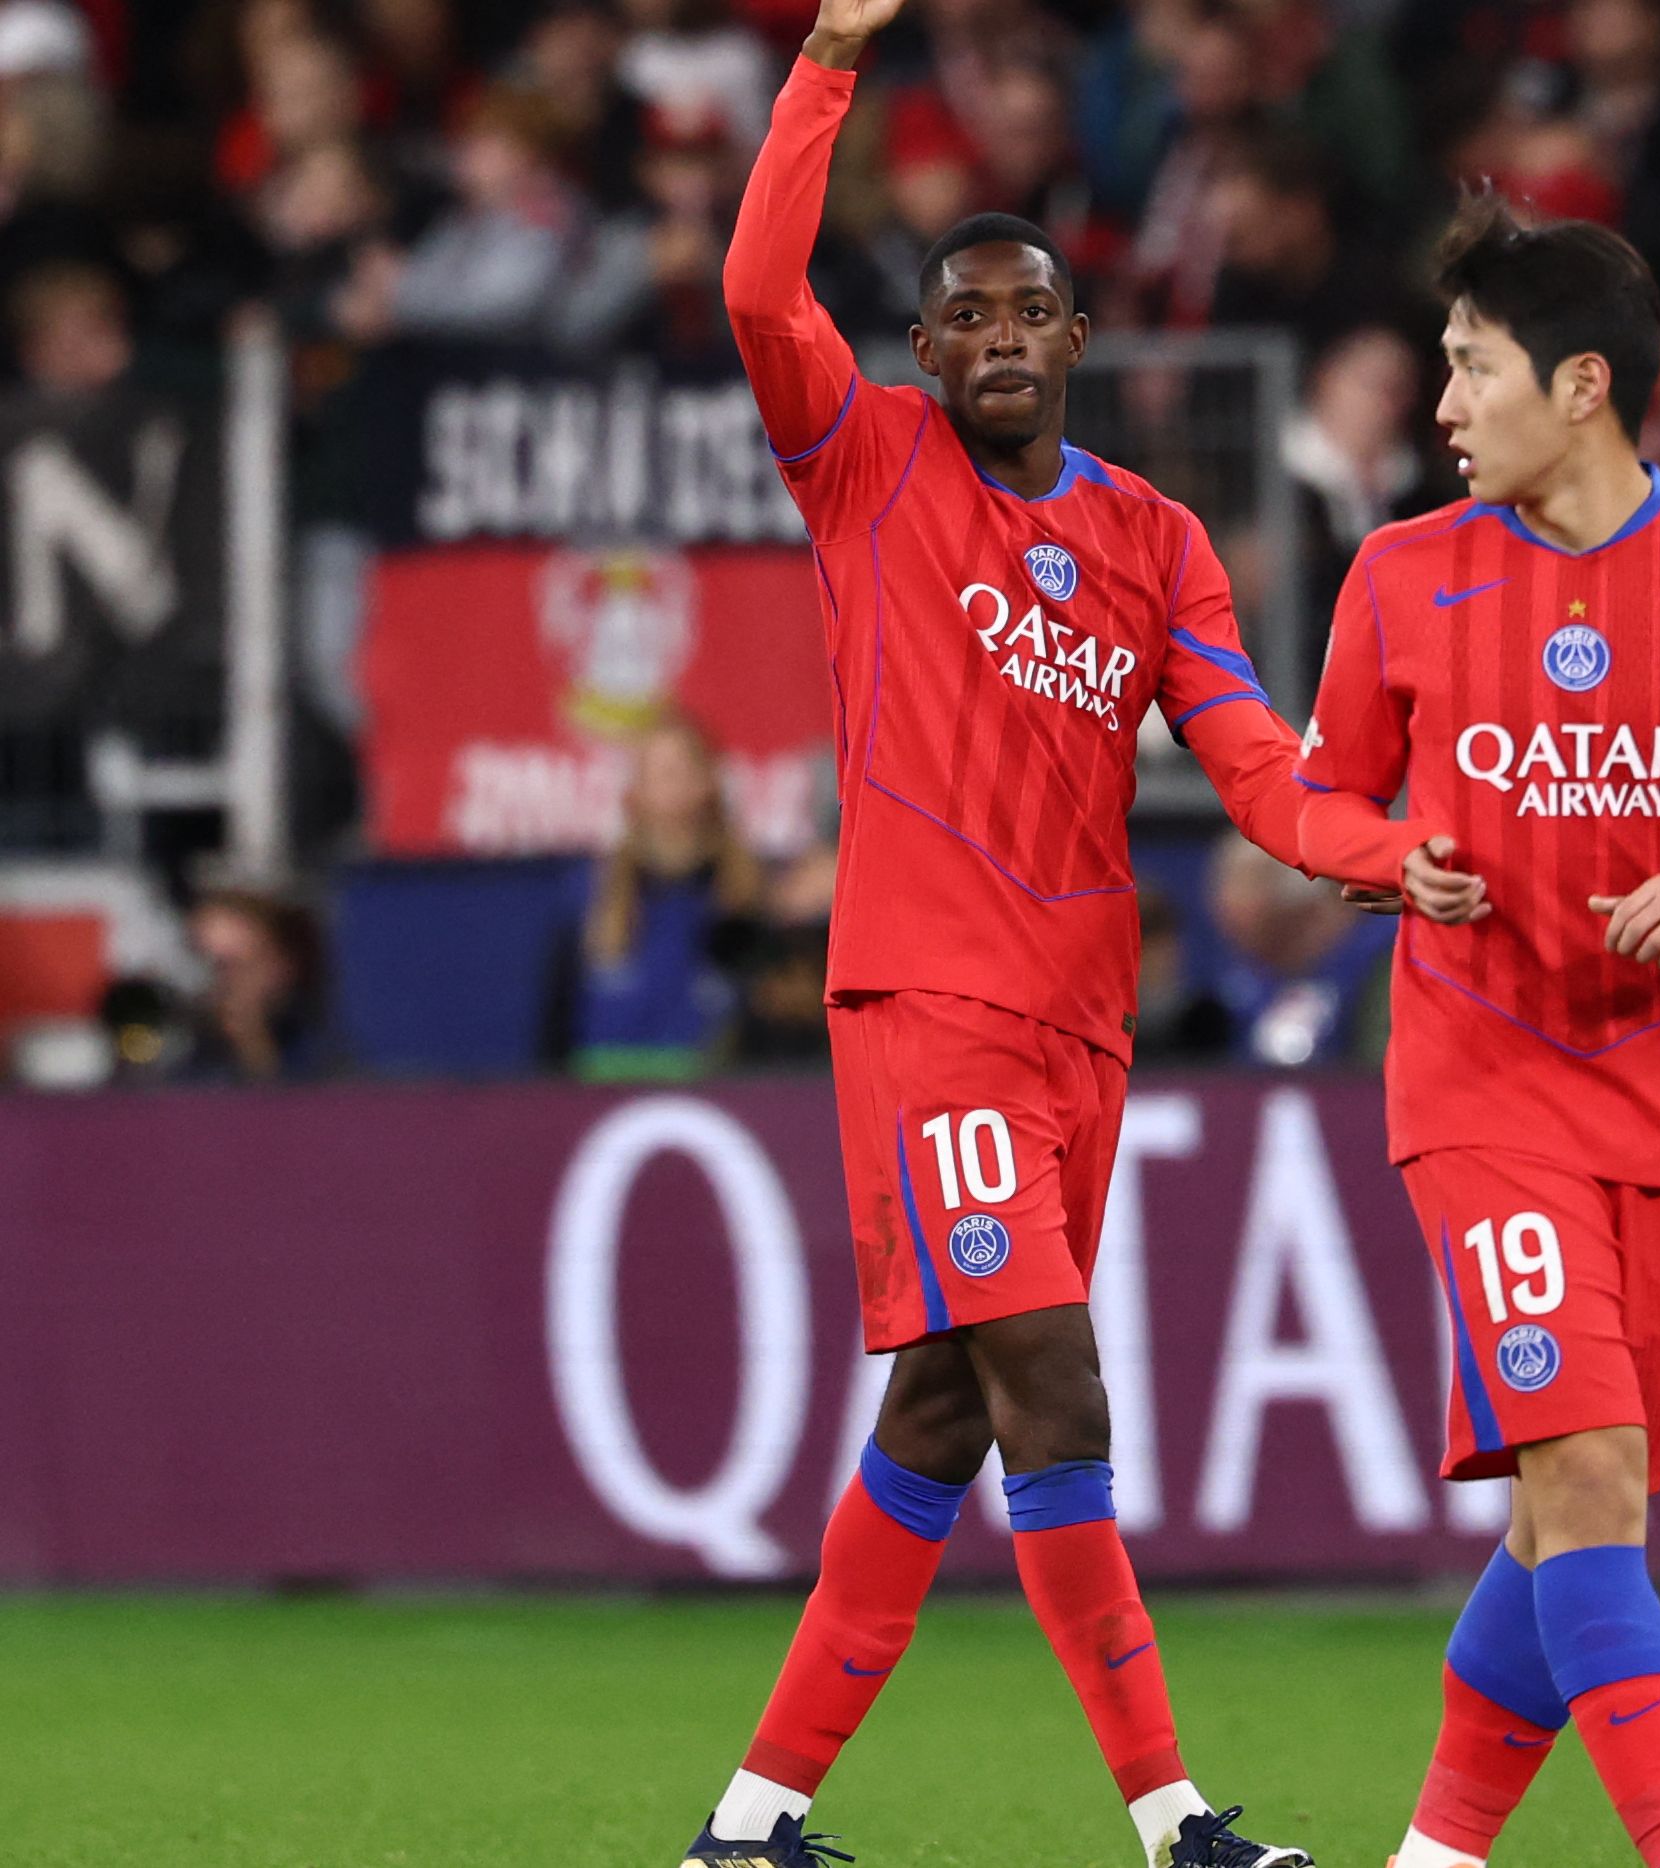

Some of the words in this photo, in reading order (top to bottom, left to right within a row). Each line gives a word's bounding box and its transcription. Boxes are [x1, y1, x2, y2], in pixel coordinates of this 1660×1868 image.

[1030, 549, 1068, 566] PARIS
[958, 583, 1136, 698] QATAR
[922, 1108, 1017, 1210] 10
[955, 1218, 994, 1236] PARIS
[1464, 1211, 1565, 1324] 19
[545, 1088, 1514, 1578] QTA
